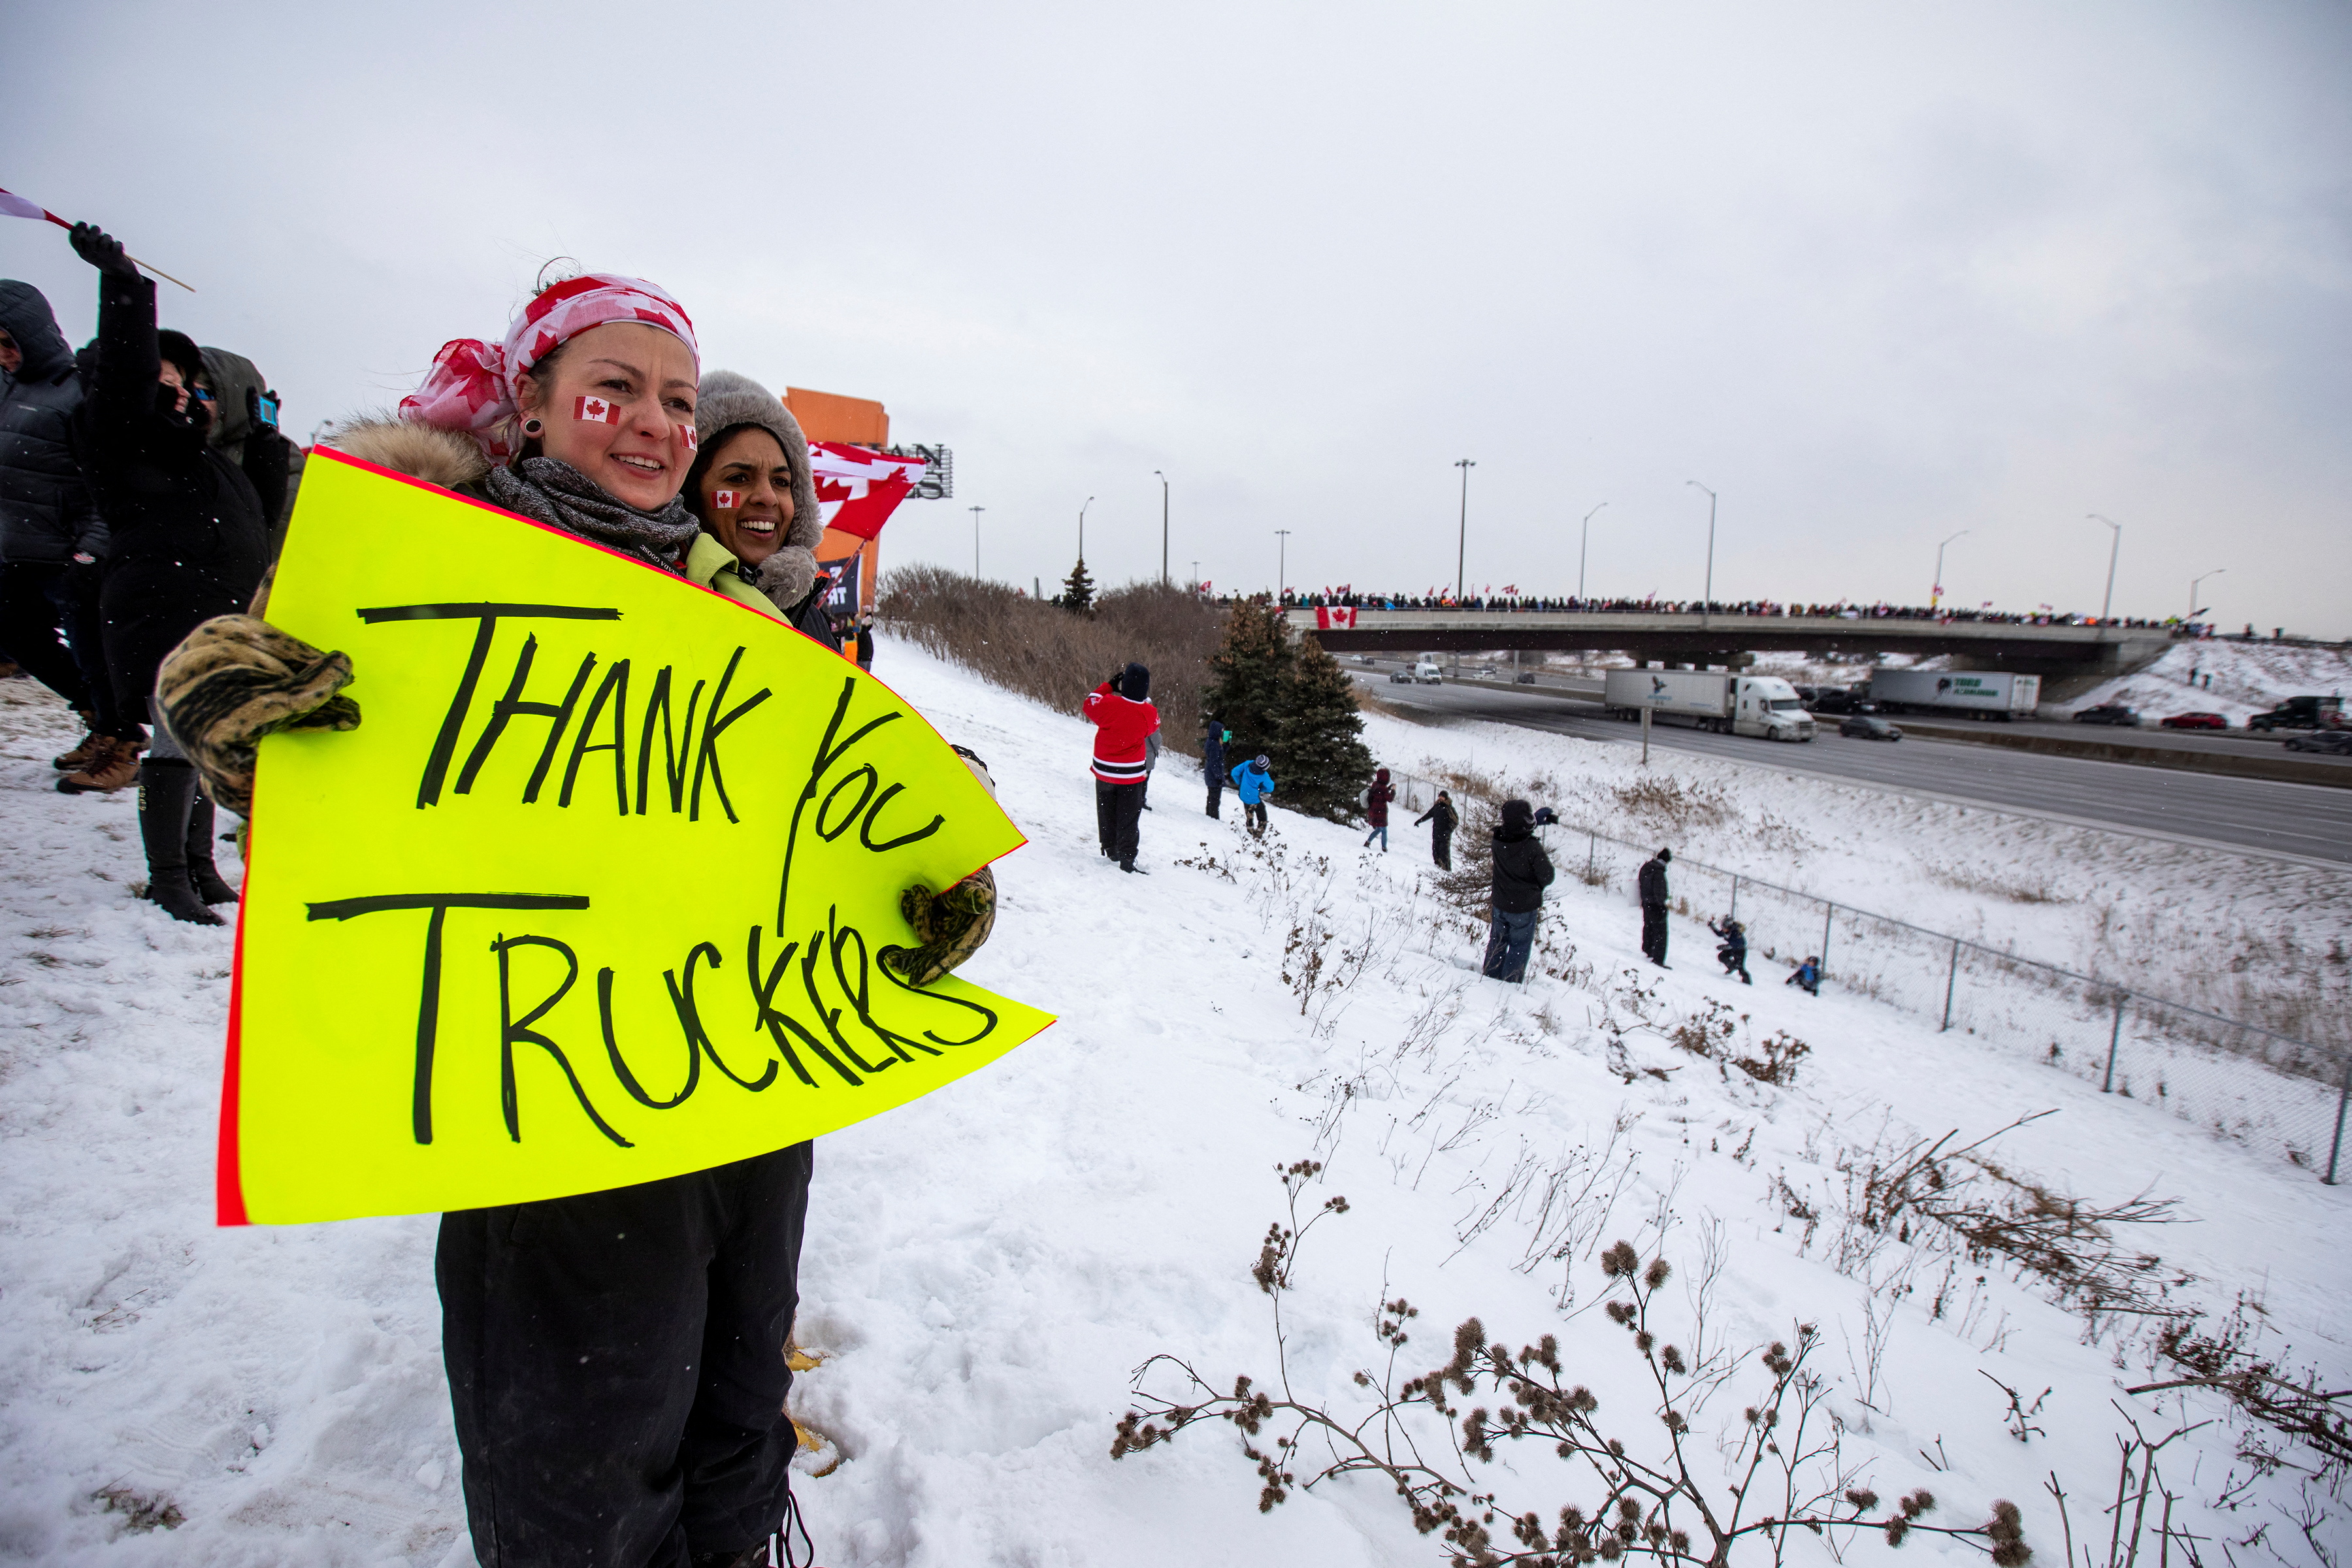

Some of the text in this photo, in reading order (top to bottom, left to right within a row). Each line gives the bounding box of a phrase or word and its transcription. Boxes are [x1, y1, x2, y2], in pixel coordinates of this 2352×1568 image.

[640, 544, 660, 563] GOOSE
[357, 601, 772, 824] THANK
[306, 893, 998, 1147] TRUCKERS
